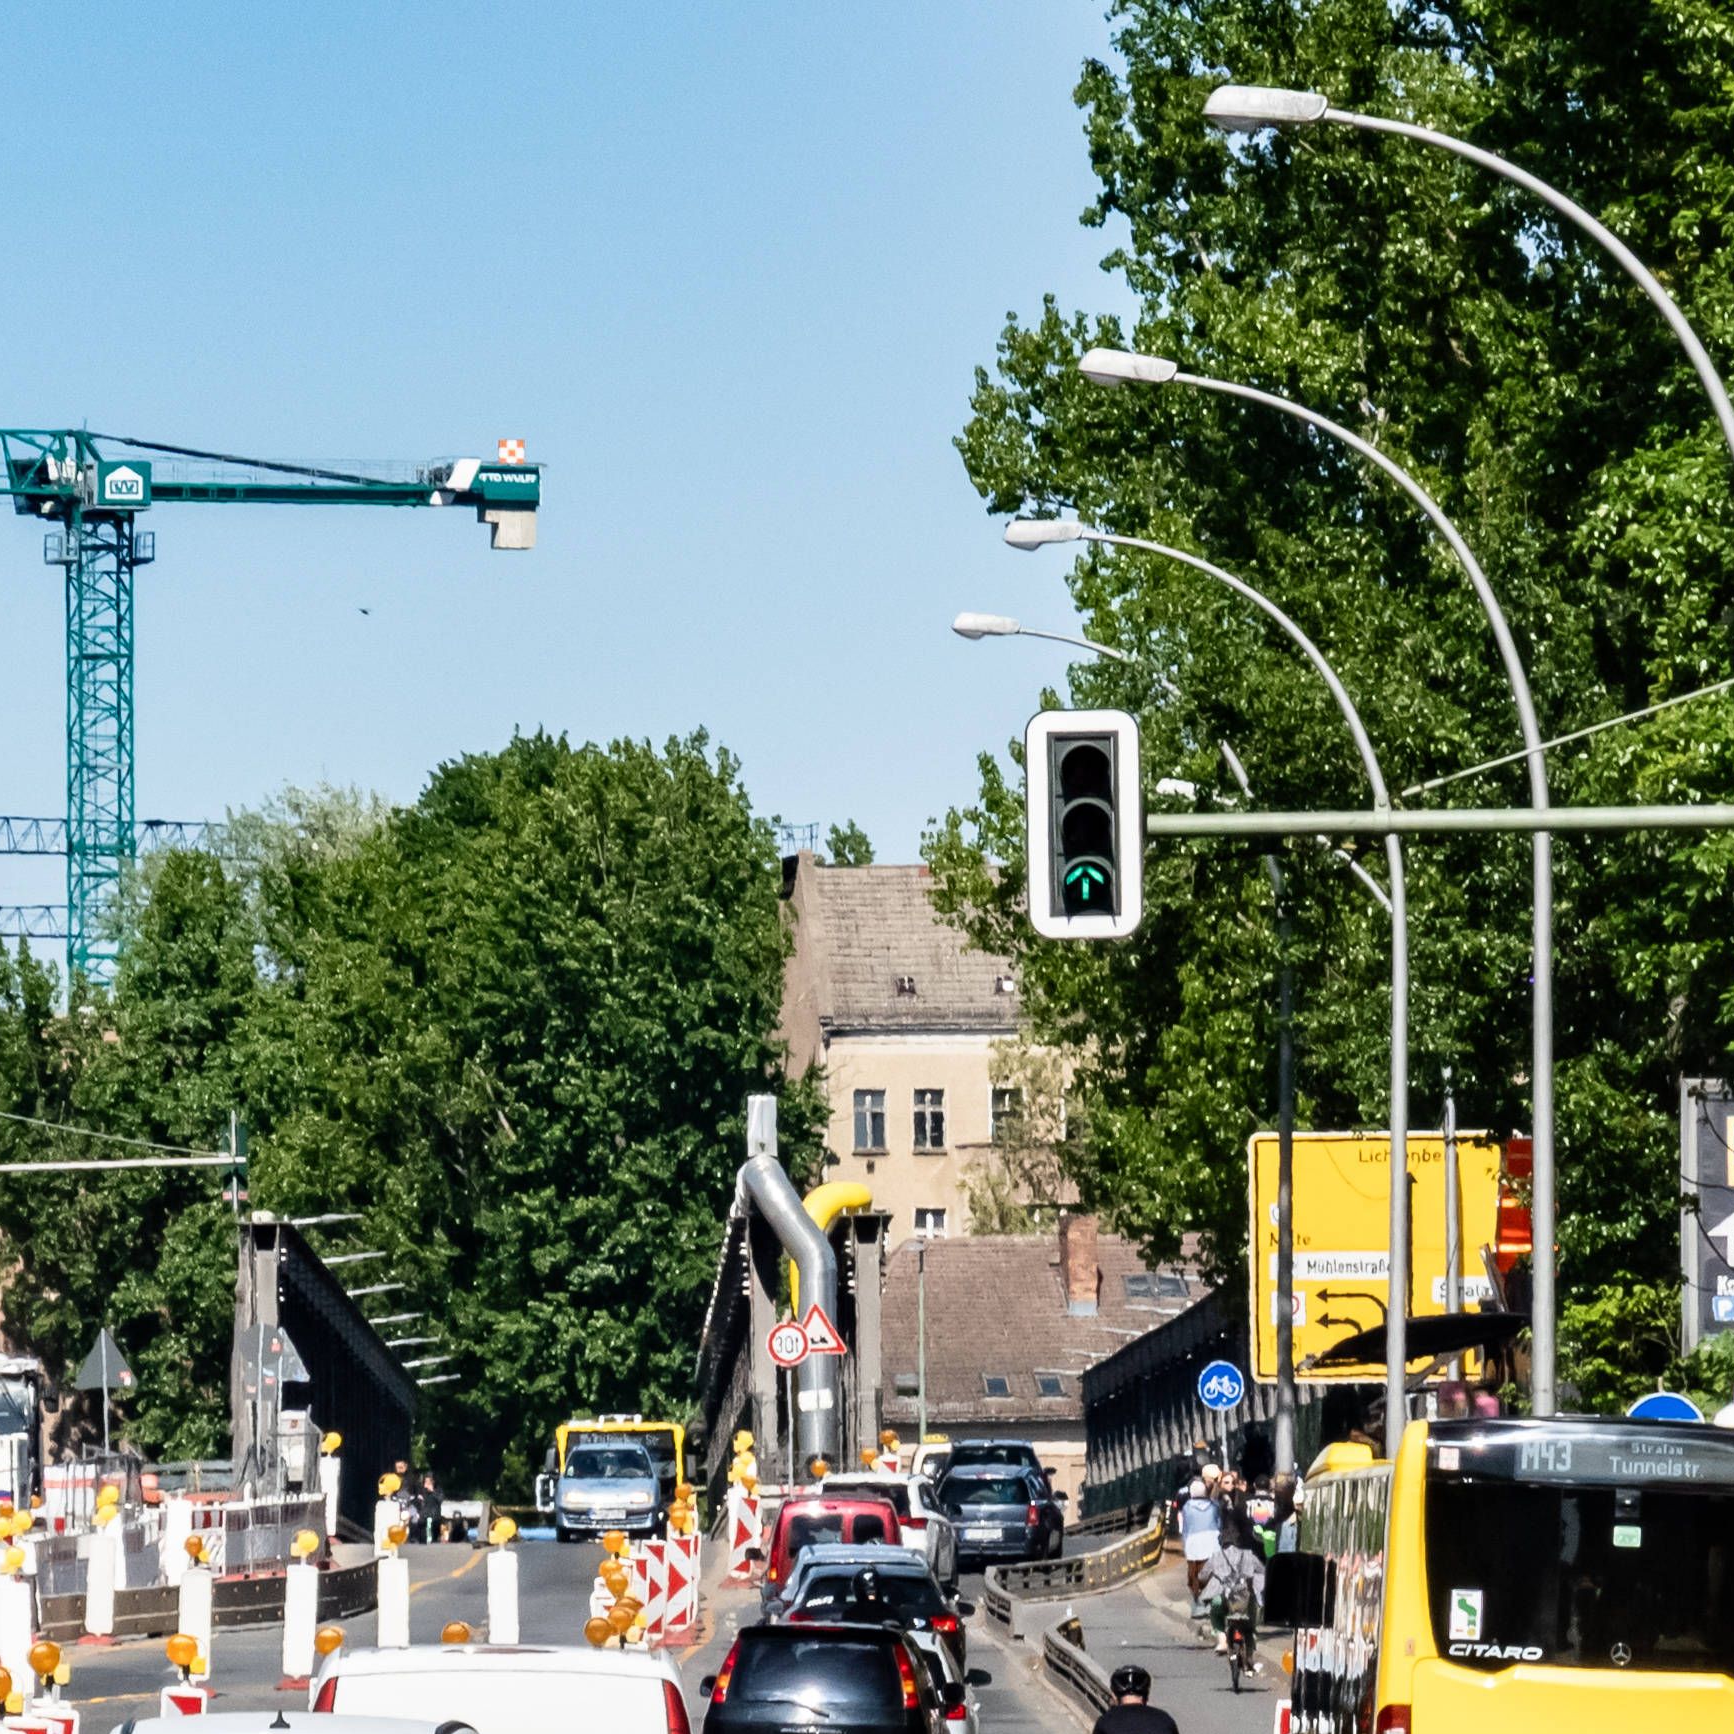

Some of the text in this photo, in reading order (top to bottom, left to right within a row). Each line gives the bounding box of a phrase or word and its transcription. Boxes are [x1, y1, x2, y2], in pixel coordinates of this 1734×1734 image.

[1521, 1439, 1572, 1472] M43
[1609, 1455, 1705, 1478] Tunnelstr.
[1448, 1643, 1543, 1661] CITARO
